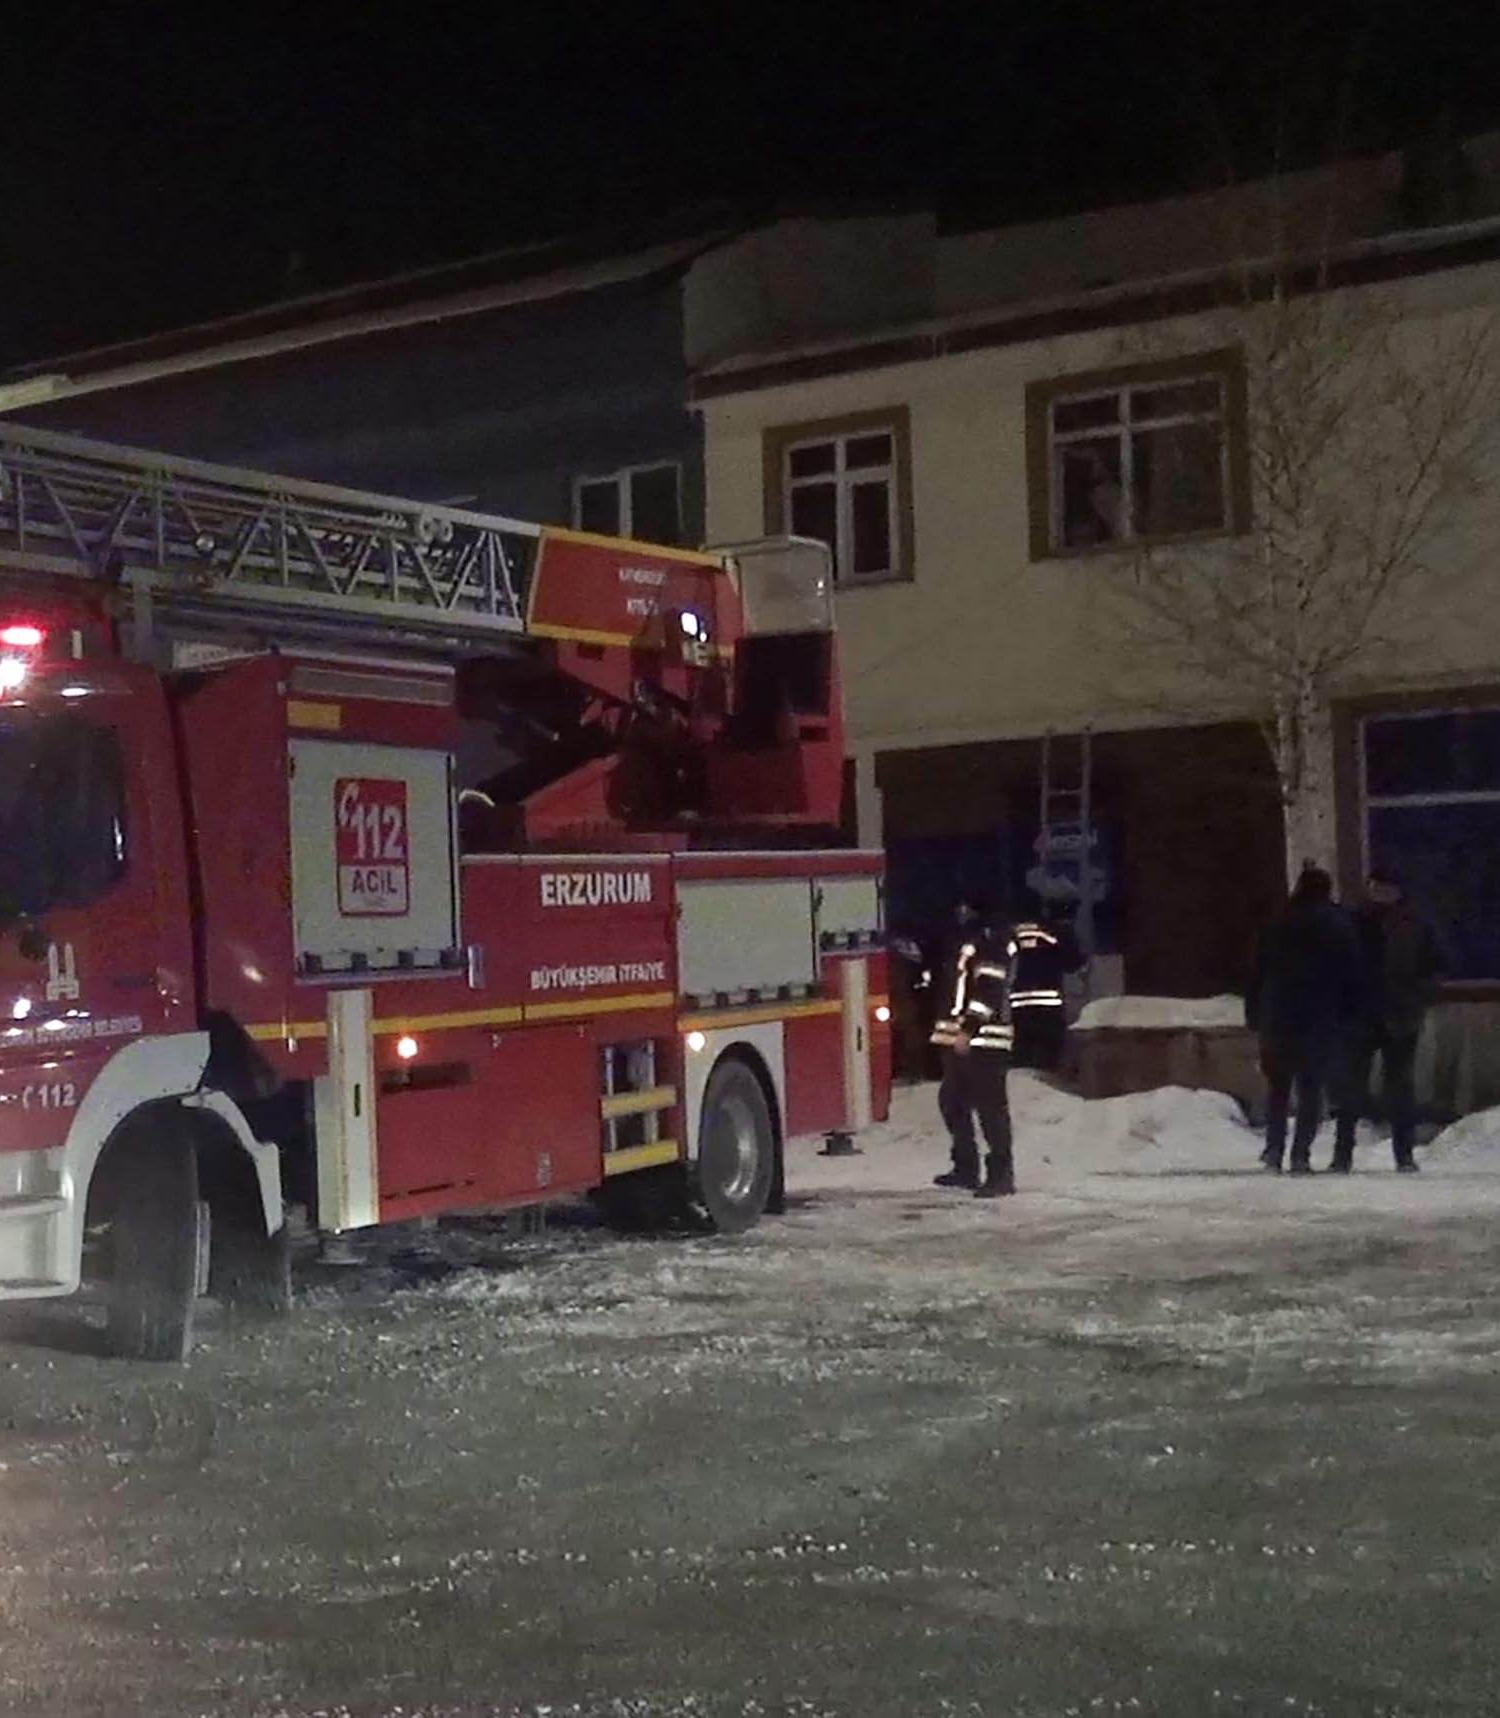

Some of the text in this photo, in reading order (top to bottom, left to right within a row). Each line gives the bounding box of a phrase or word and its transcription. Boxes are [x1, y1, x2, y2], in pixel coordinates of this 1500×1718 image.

[350, 803, 404, 860] 112
[540, 871, 652, 907] ERZURUM
[38, 1082, 77, 1108] 112
